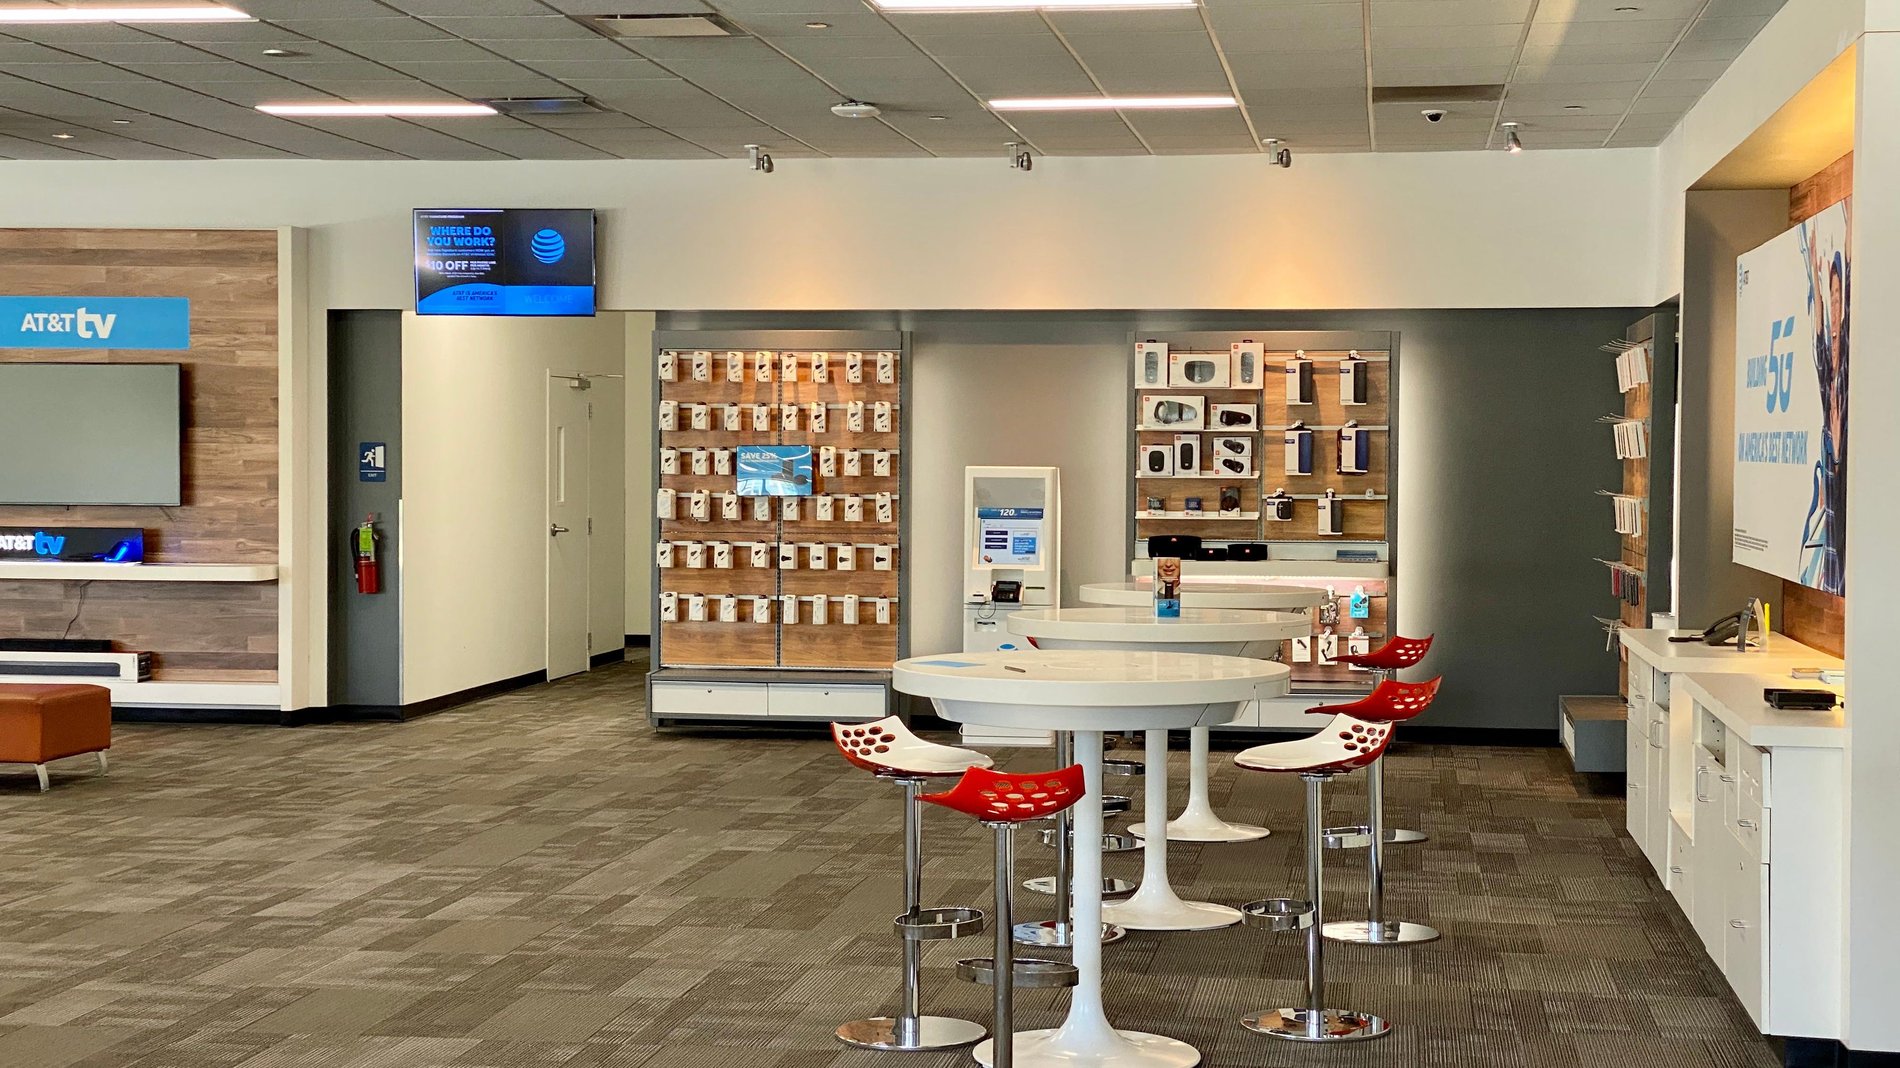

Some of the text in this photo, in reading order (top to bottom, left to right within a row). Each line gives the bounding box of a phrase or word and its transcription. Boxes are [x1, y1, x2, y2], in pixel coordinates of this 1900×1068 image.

[430, 226, 492, 236] WHERE DO
[426, 237, 496, 246] YOU WORK?
[445, 260, 469, 270] OFF
[524, 294, 574, 304] WELCOME
[21, 307, 117, 339] AT&T tv
[1766, 316, 1795, 414] 5G
[761, 452, 778, 460] 25%
[1000, 508, 1015, 516] 120
[35, 531, 65, 555] tv
